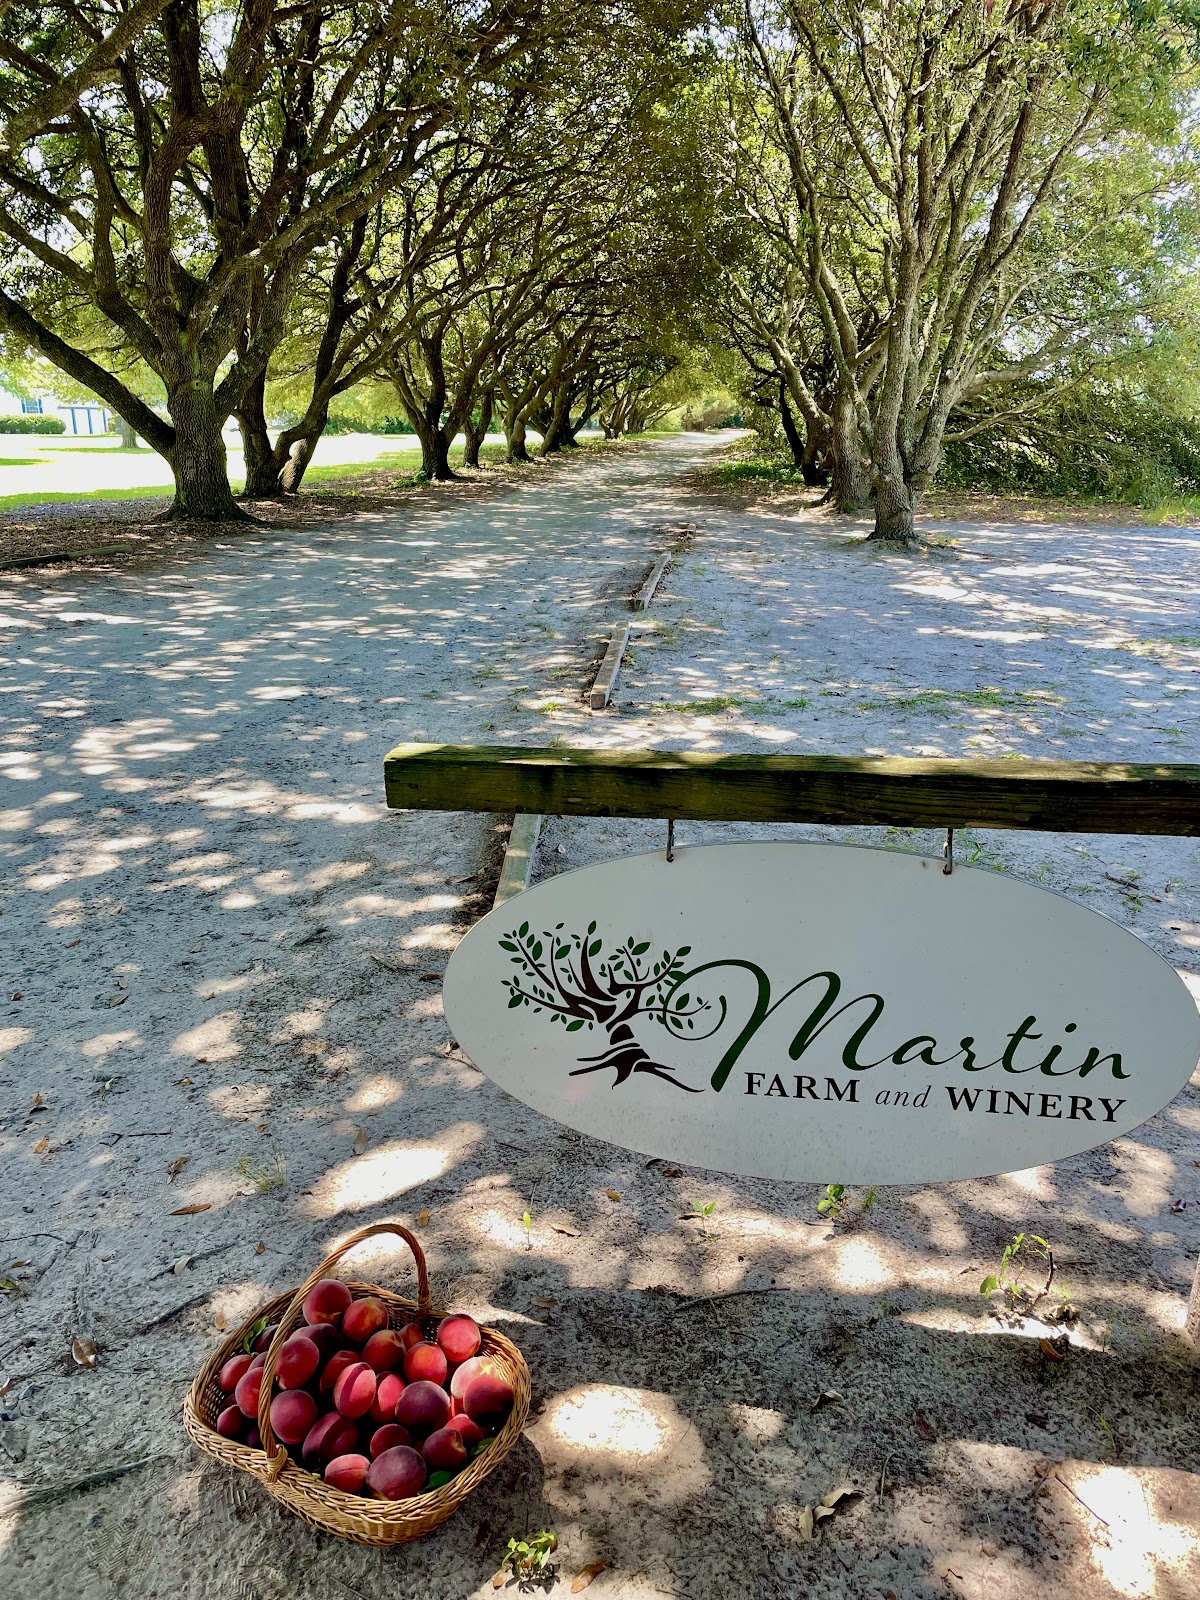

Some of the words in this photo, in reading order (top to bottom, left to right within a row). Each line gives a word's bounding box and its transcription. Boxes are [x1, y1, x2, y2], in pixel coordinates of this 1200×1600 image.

[662, 958, 1131, 1093] Martin
[743, 1071, 860, 1103] FARM
[874, 1084, 932, 1109] and
[945, 1086, 1127, 1123] WINERY
